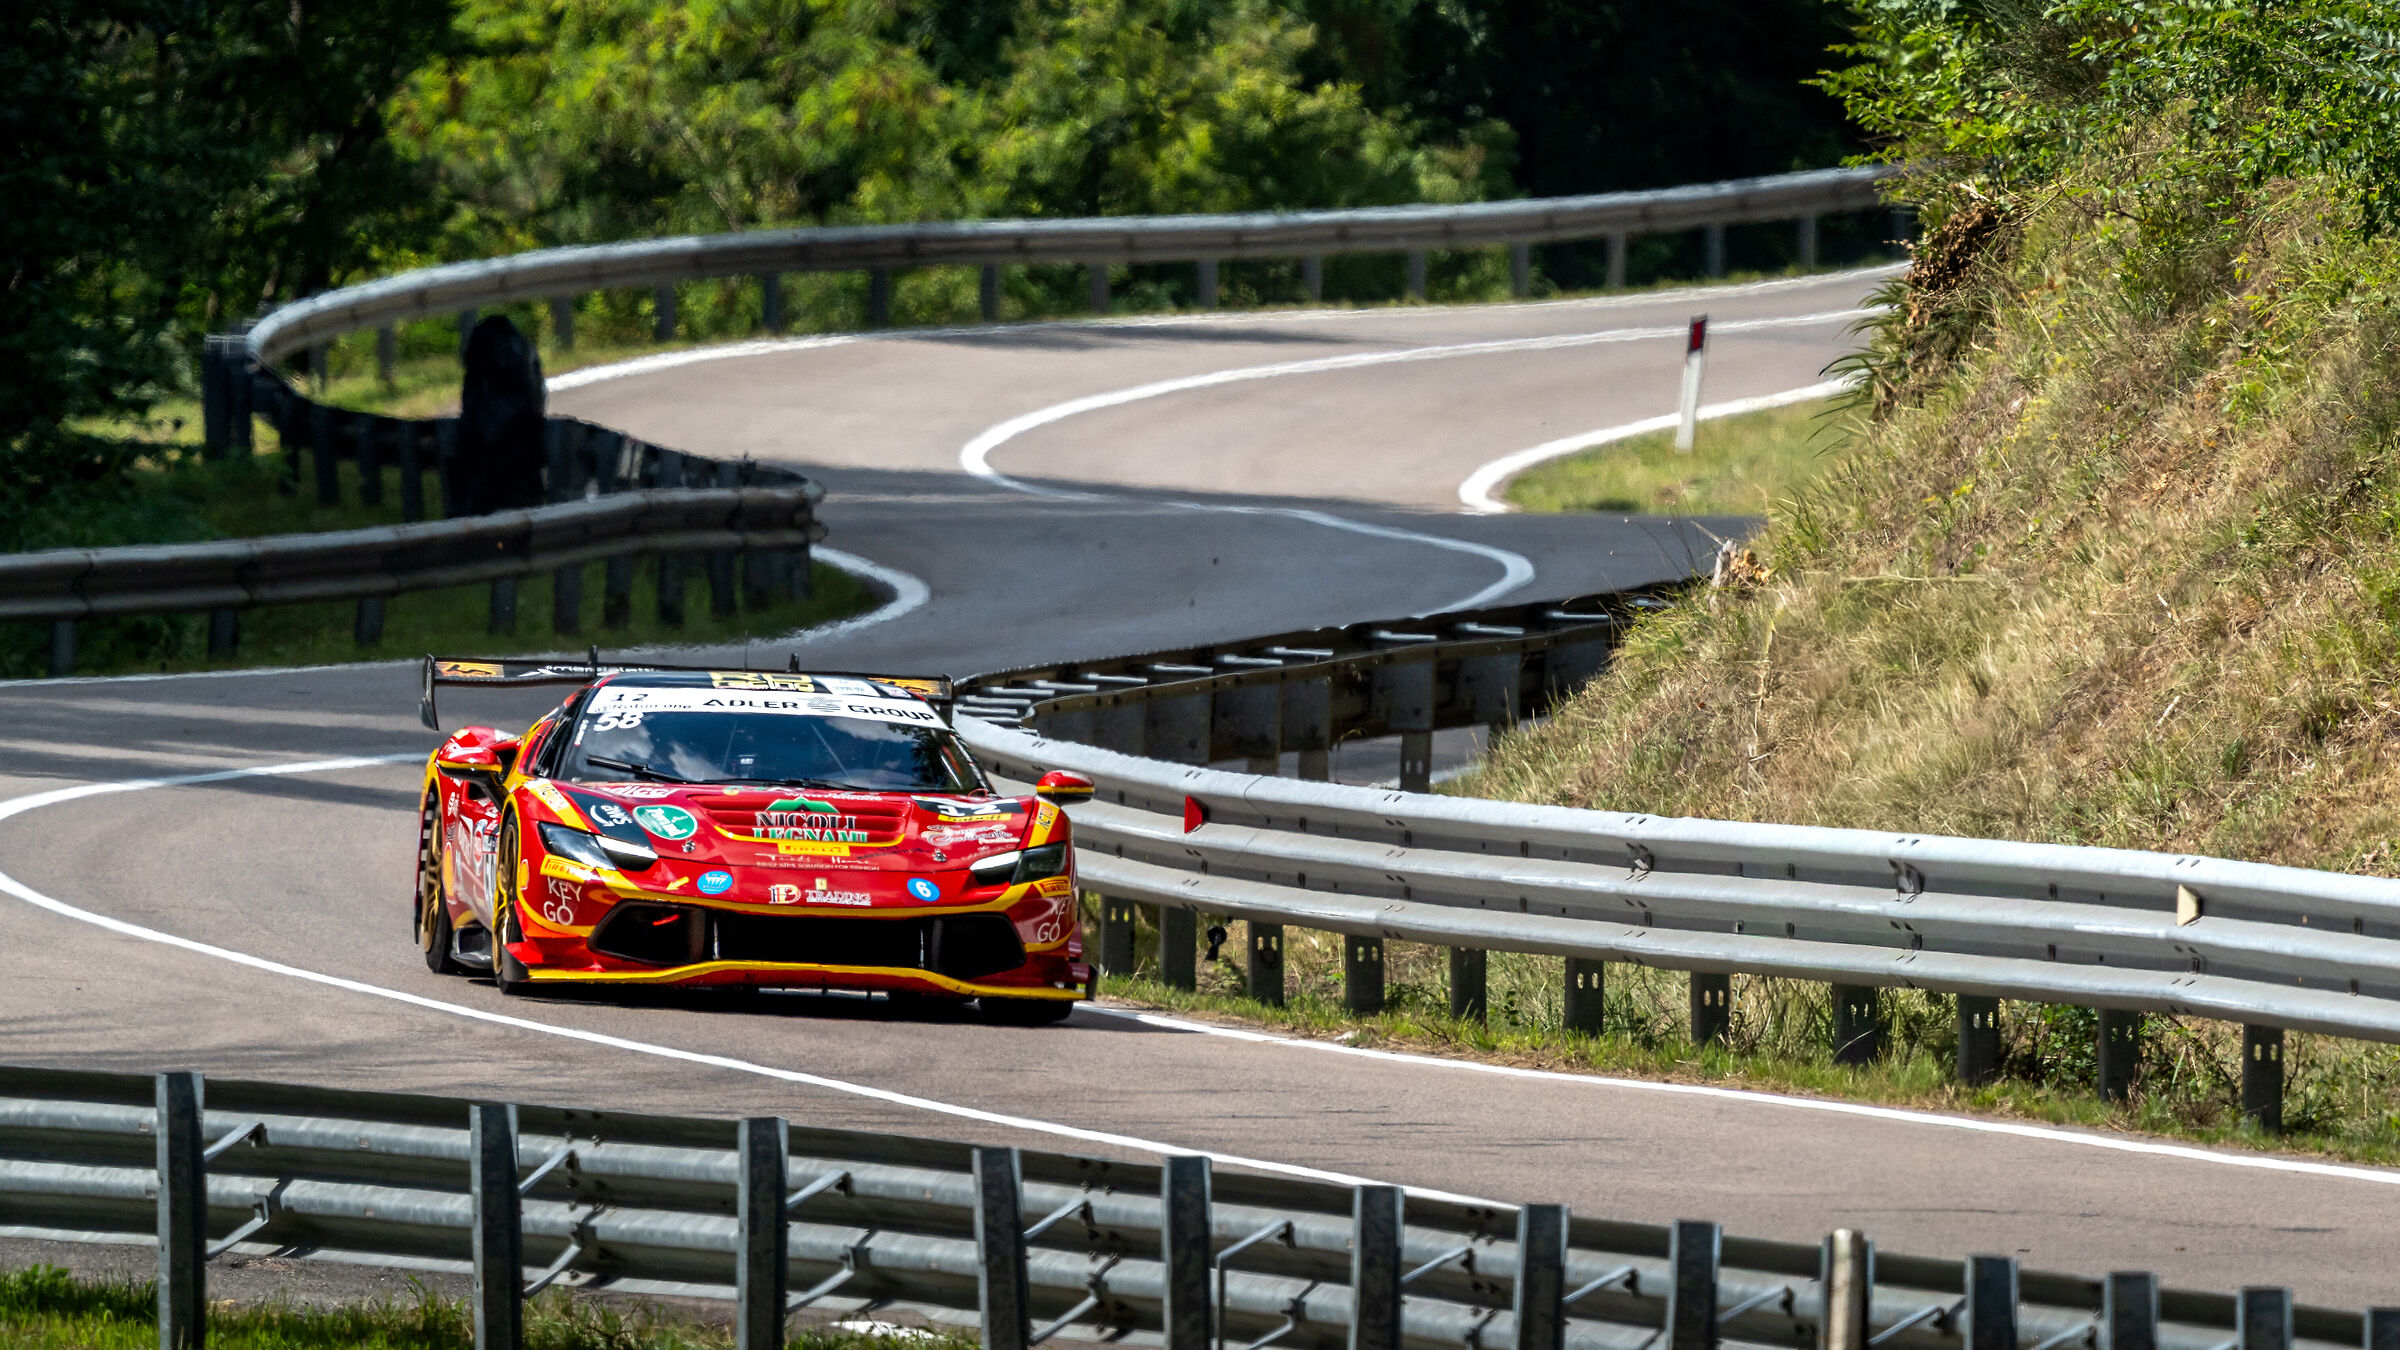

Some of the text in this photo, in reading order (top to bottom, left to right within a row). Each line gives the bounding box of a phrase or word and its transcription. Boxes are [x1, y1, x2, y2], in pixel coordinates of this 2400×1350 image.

[703, 698, 935, 721] ADLER GROUP
[593, 712, 644, 732] 58
[754, 811, 858, 829] NICOLI
[752, 827, 869, 843] LEGNAMI
[547, 876, 583, 902] KEY
[804, 889, 872, 903] TRADING
[915, 880, 932, 898] 6
[543, 900, 575, 926] GO
[1036, 922, 1061, 943] GO
